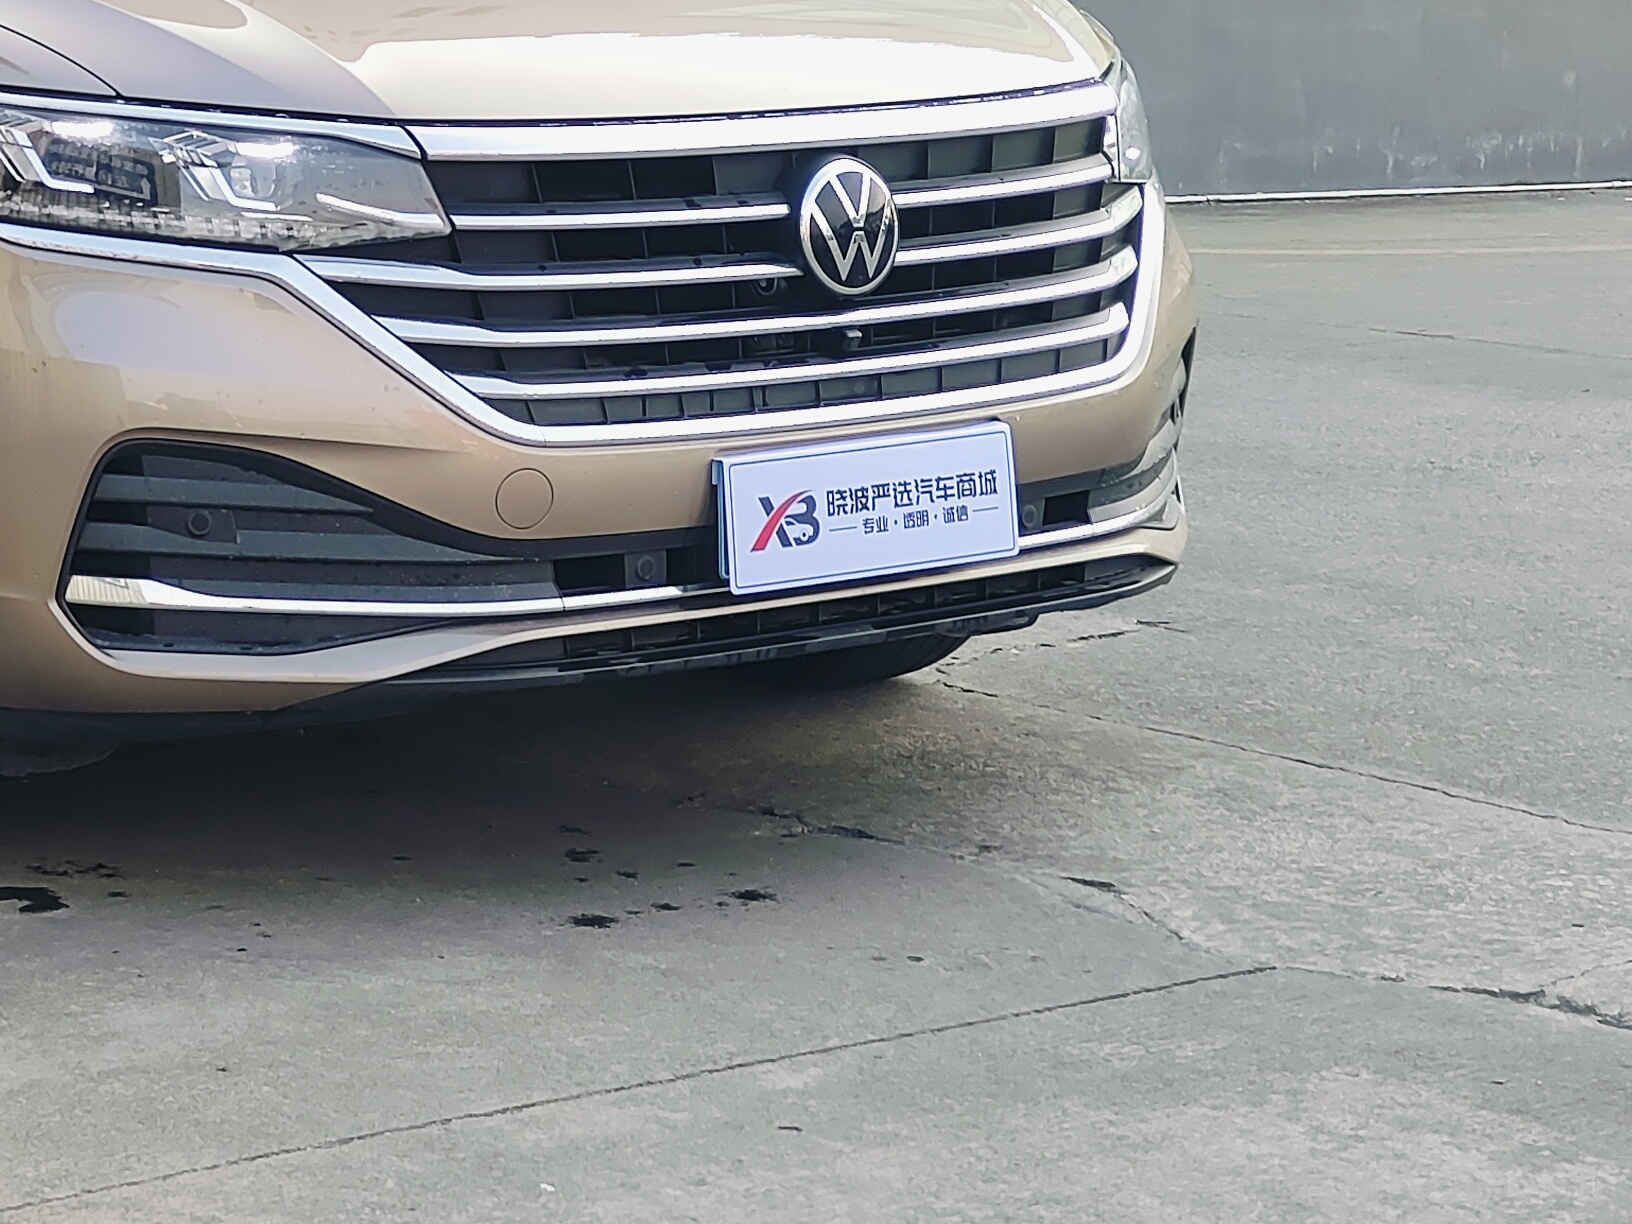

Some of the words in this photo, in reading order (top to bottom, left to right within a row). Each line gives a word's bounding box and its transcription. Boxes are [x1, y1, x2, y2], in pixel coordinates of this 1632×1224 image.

[805, 163, 893, 285] VW
[826, 469, 998, 517] 晓波严选汽车商城
